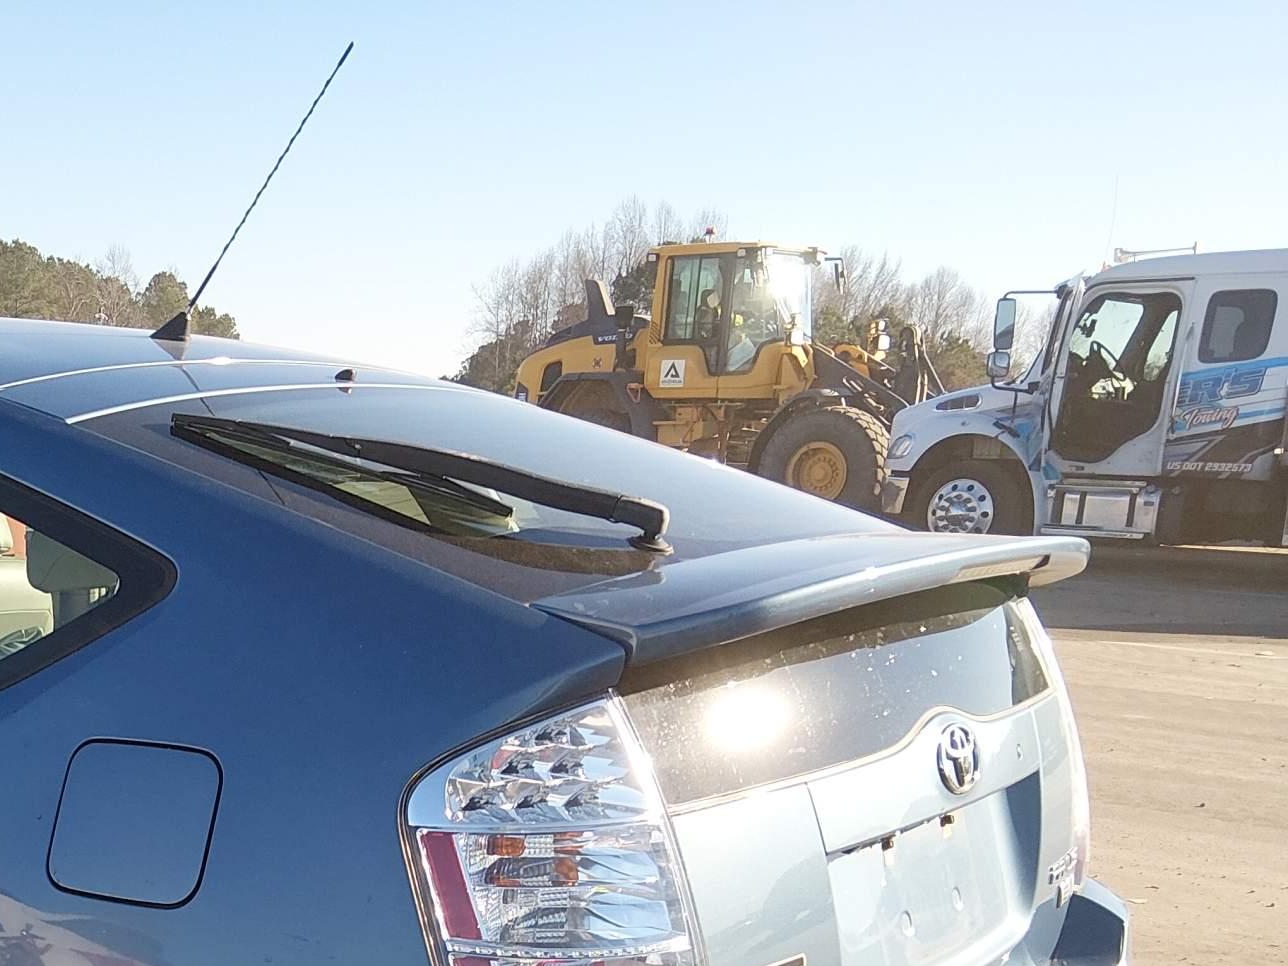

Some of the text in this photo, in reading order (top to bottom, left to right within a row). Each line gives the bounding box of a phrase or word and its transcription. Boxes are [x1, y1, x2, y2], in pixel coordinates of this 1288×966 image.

[597, 332, 633, 342] VOLO
[1181, 405, 1240, 431] Towing
[1167, 461, 1182, 470] US
[1182, 462, 1204, 471] DOT
